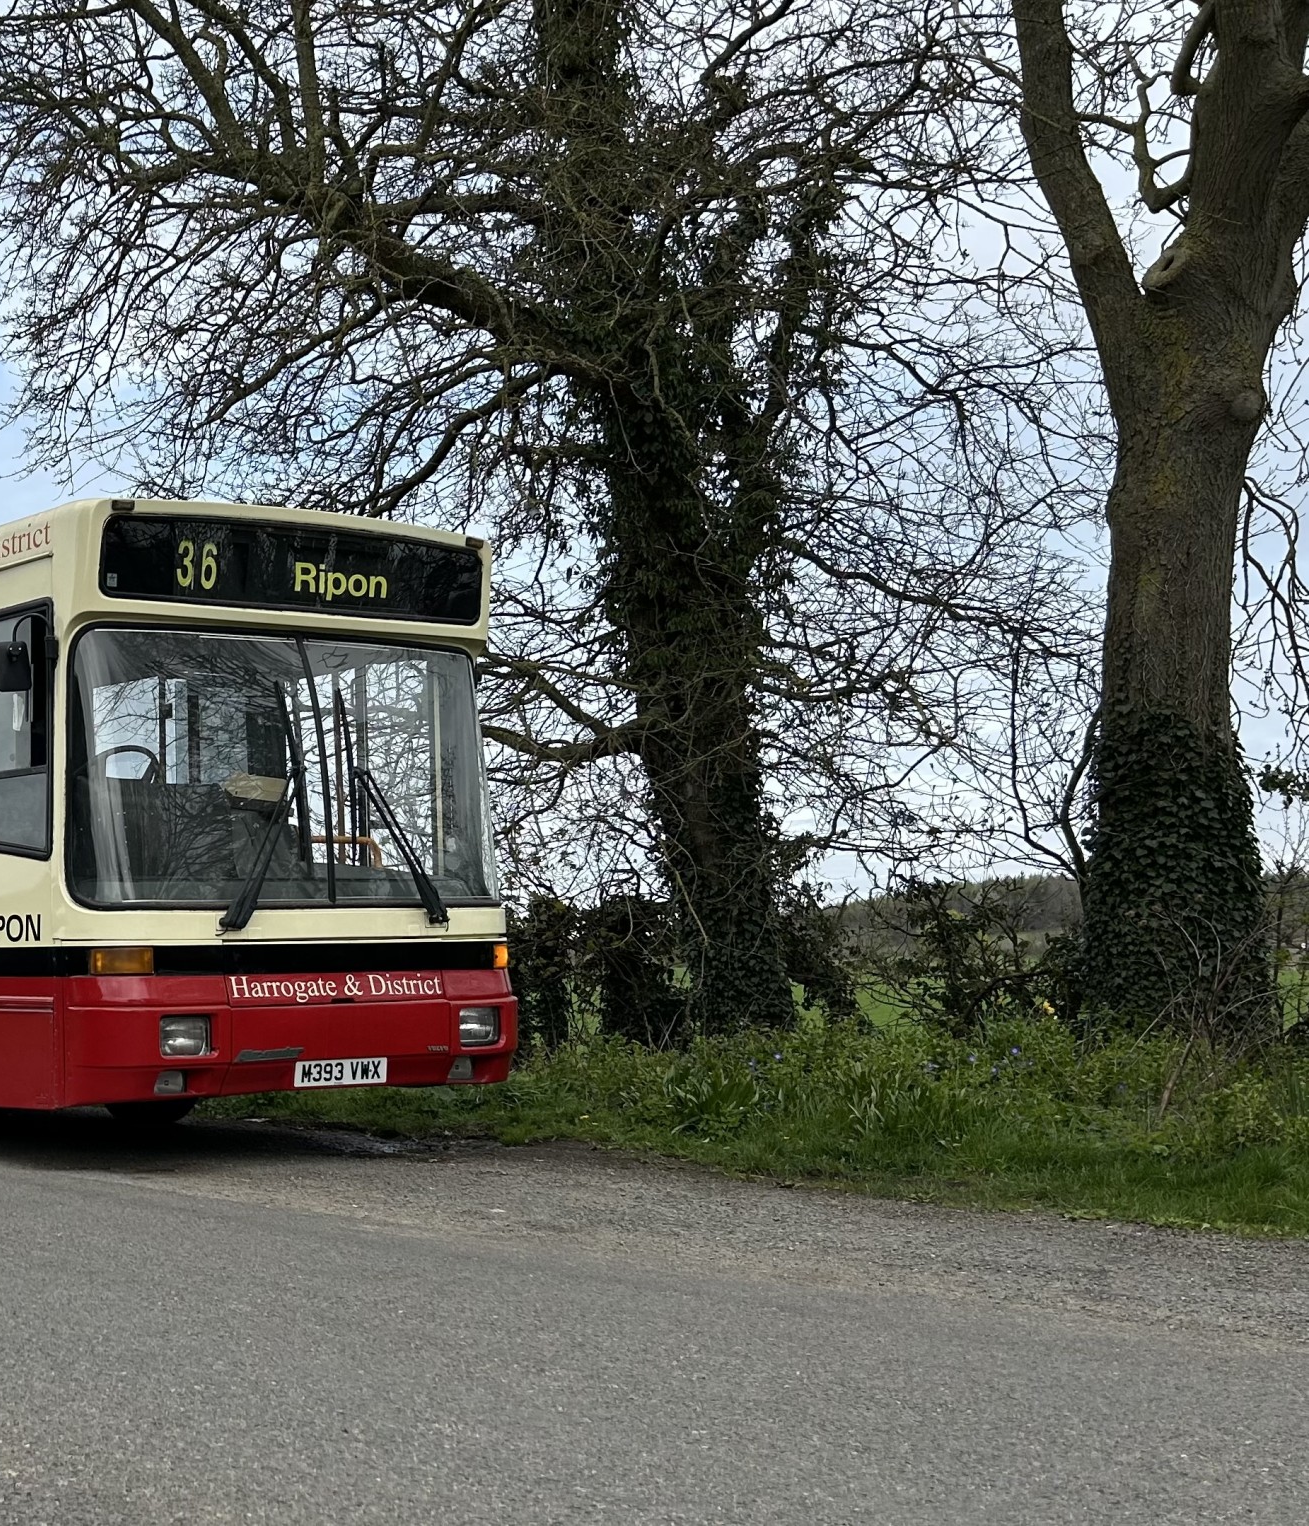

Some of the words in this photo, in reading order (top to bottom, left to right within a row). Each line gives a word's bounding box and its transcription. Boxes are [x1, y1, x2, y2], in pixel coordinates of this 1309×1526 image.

[176, 538, 217, 590] 36
[294, 561, 388, 600] Ripon
[230, 976, 338, 1002] Harrogate
[343, 974, 364, 995] &
[368, 974, 443, 996] District
[301, 1062, 344, 1083] M393
[351, 1060, 381, 1080] VWX
